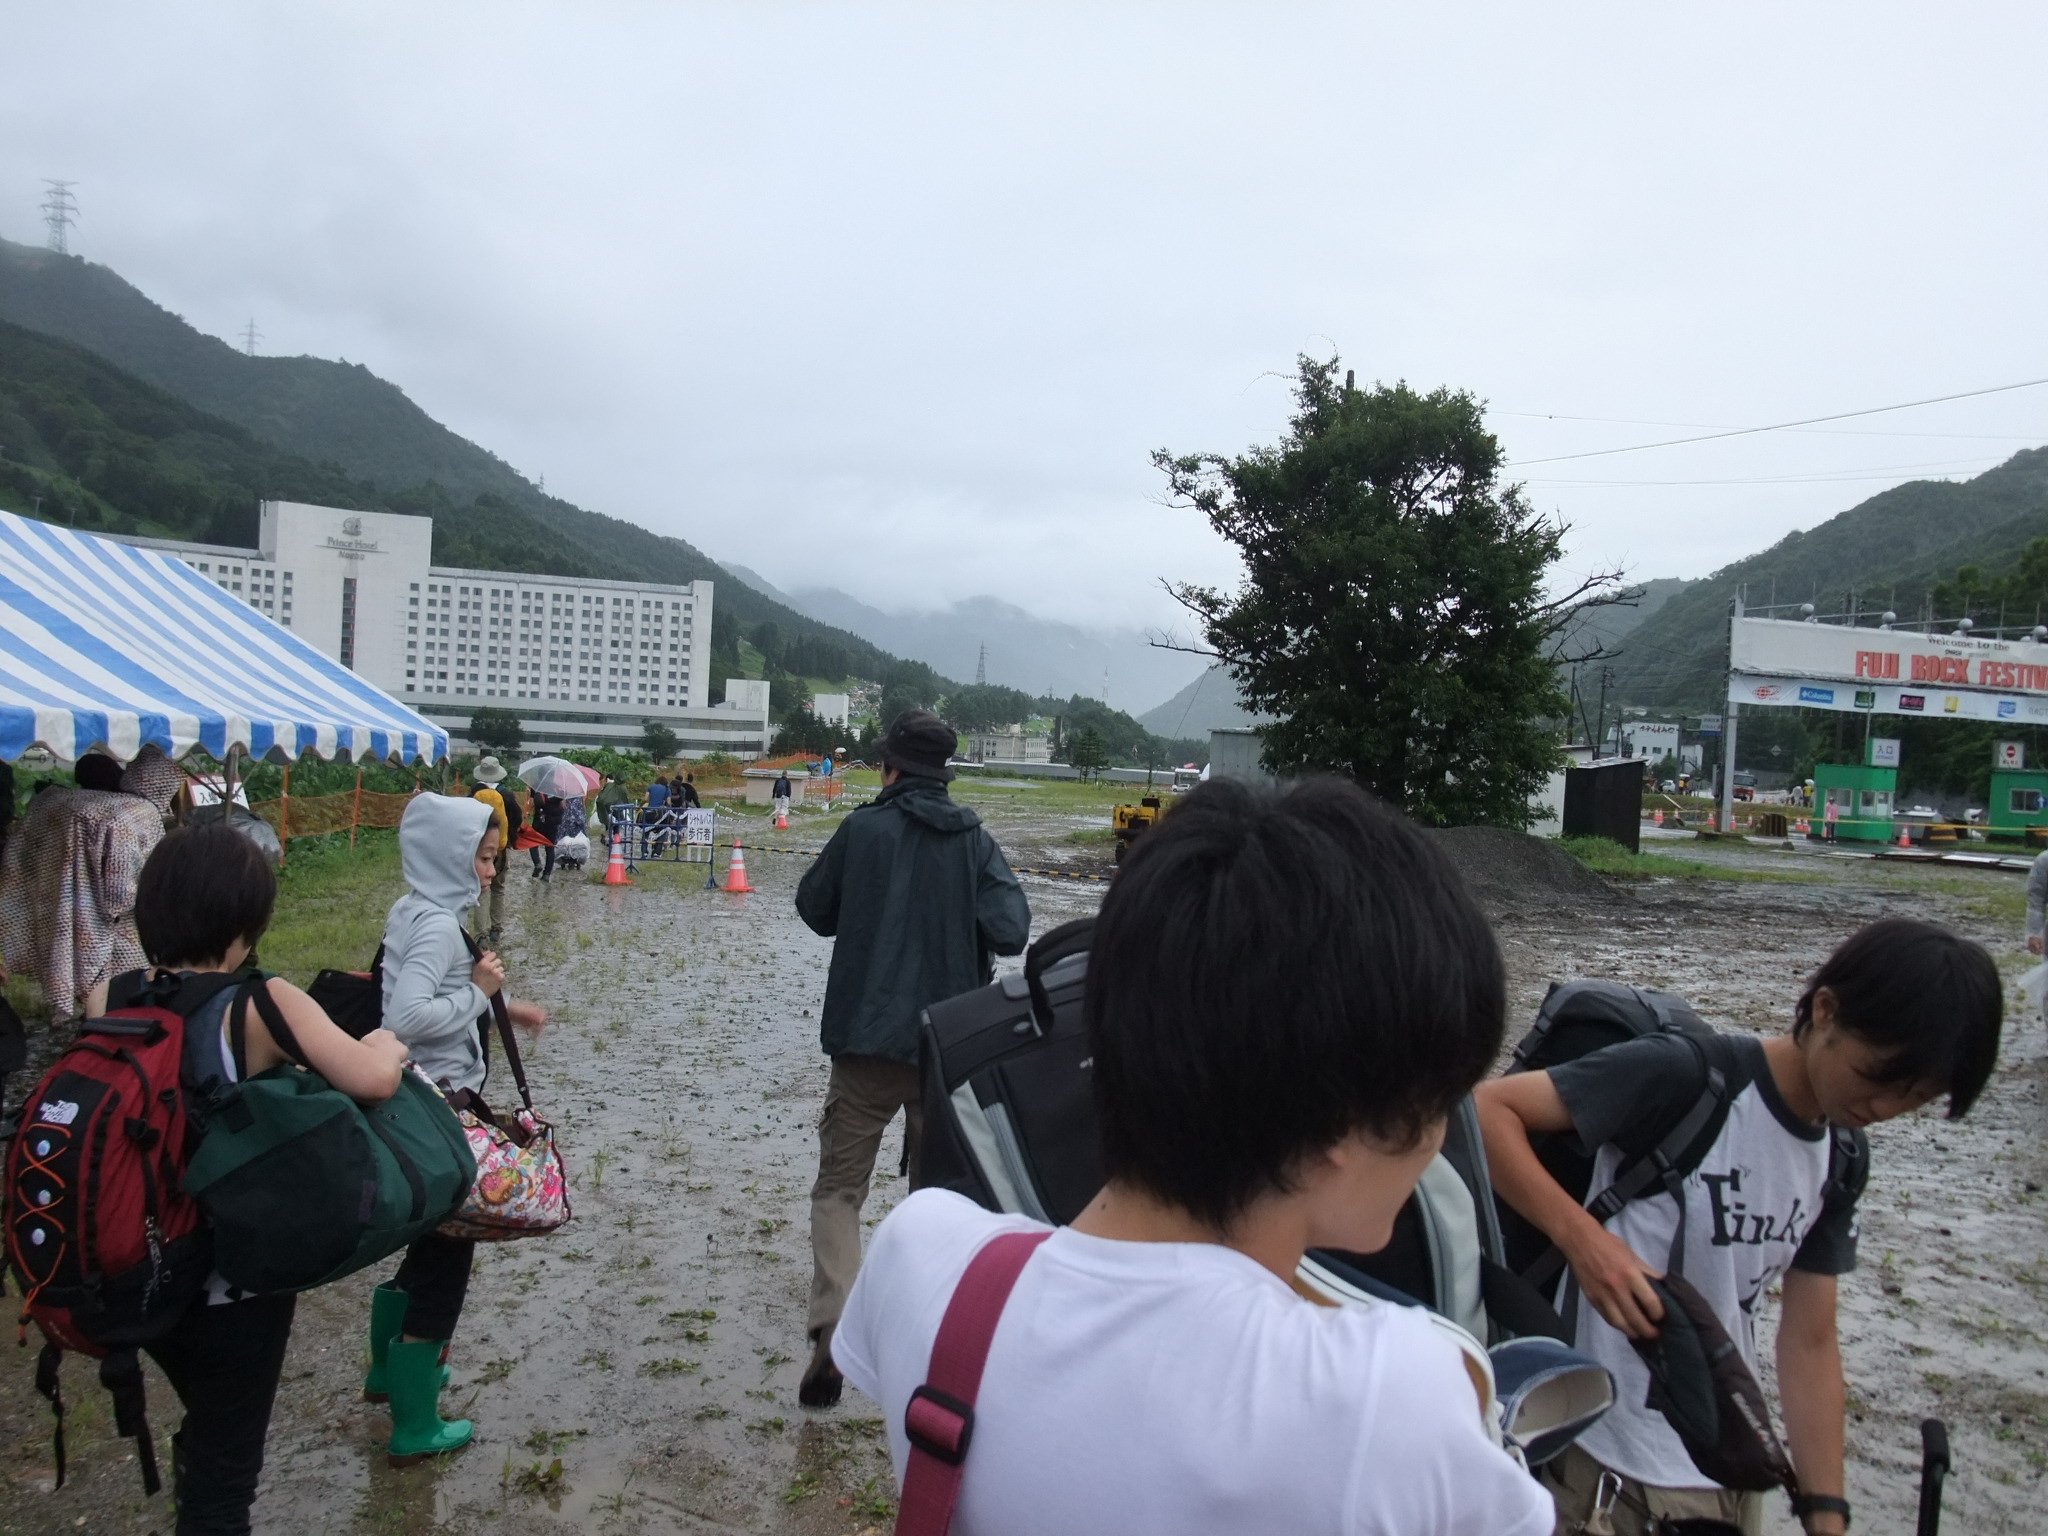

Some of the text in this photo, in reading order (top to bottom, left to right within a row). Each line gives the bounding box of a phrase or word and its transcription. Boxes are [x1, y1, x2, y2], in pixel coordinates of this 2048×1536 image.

[327, 536, 378, 549] Prince Hotel
[1926, 634, 2010, 651] Welcome to the
[1855, 650, 2048, 691] FUJI ROCK FESTIV
[1876, 744, 1894, 755] 入口
[689, 812, 713, 826] シャトルバス
[689, 827, 711, 842] 歩行者
